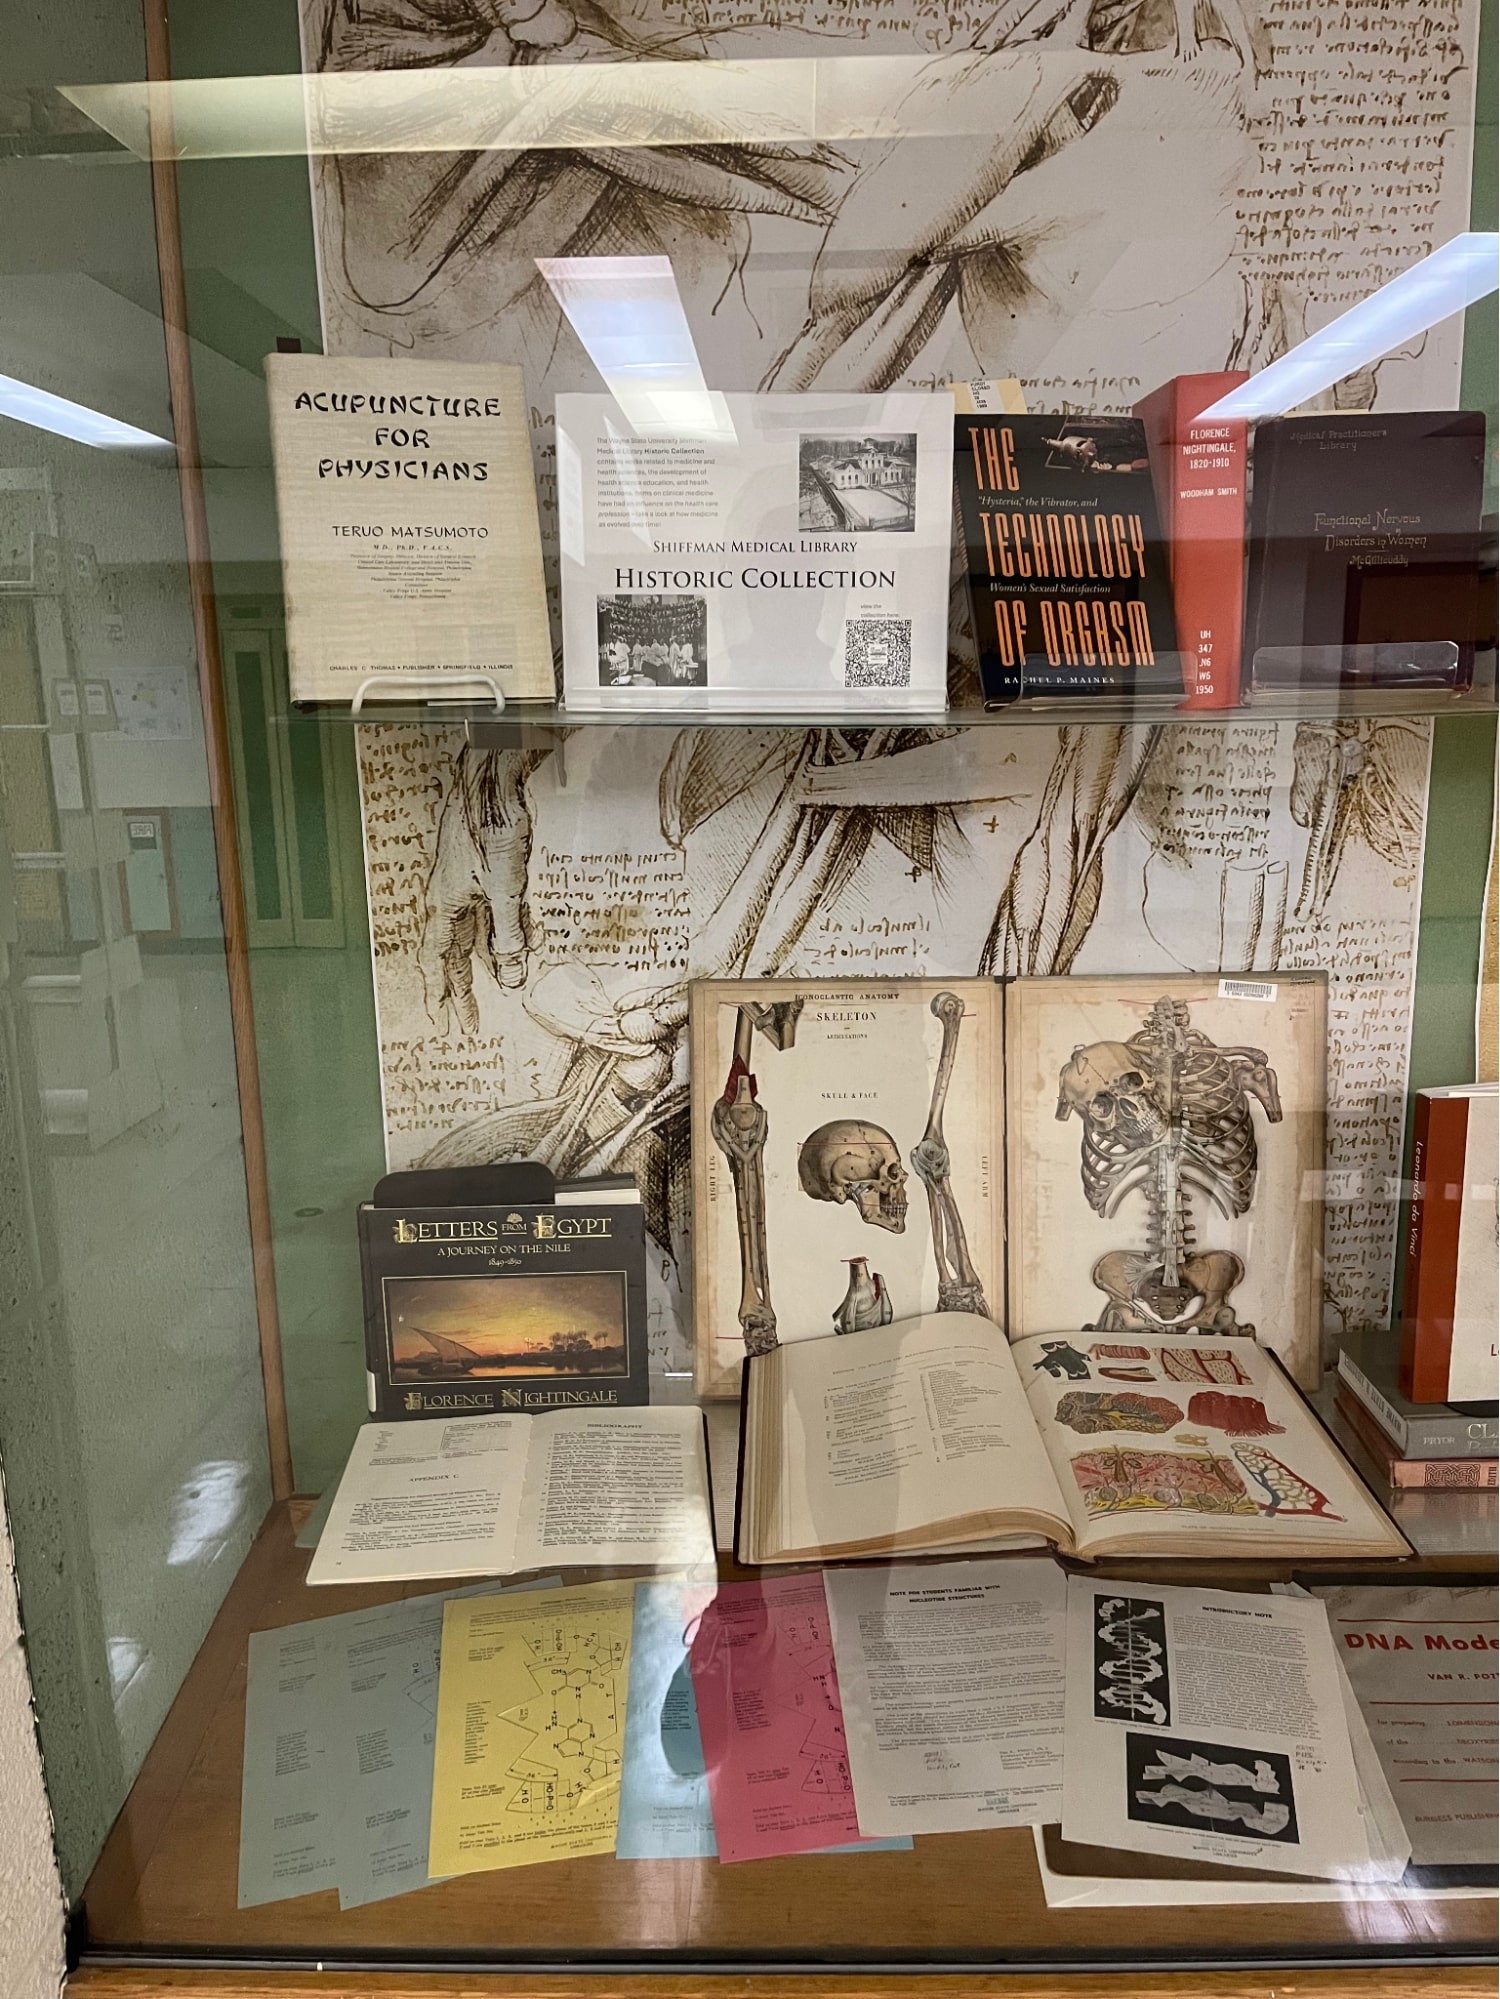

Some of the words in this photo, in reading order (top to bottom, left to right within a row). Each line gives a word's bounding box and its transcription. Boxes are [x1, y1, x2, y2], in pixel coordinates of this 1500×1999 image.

[294, 392, 501, 417] ACUPUNCTURE
[375, 427, 430, 448] FOR
[1190, 427, 1230, 439] FLORENCE
[1182, 442, 1237, 456] NIGHTINGALE,
[1319, 441, 1357, 451] Library
[968, 426, 1020, 492] THE
[1189, 457, 1230, 470] 1820-1910
[318, 458, 489, 481] PHYSICIANS
[659, 468, 700, 476] development
[1180, 489, 1214, 499] WOODHAM
[1217, 487, 1238, 498] SMITH
[1025, 496, 1040, 507] the
[1040, 496, 1079, 508] Vibrator,
[1080, 497, 1098, 508] and
[1314, 512, 1371, 531] Functional
[1372, 508, 1421, 530] Nervous
[332, 525, 384, 538] TERUO
[391, 526, 489, 539] MATSUMOTO
[653, 540, 726, 553] SHIFFMAN
[731, 540, 796, 553] MEDICAL
[800, 540, 858, 553] LIBRARY
[979, 511, 1147, 579] TECHNOLOGY
[1325, 534, 1375, 551] Disorders
[1378, 537, 1386, 548] in
[1386, 531, 1427, 550] Women
[615, 567, 734, 589] HISTORIC
[741, 567, 897, 589] COLLECTION
[1029, 582, 1058, 593] Sexual
[1060, 582, 1111, 595] Satisfaction
[994, 600, 1028, 667] OF
[1039, 600, 1155, 667] ORGASM
[1200, 630, 1211, 639] UH
[1198, 643, 1213, 653] 347
[1004, 675, 1052, 684] RACHEL
[1070, 676, 1116, 684] MAINES
[1195, 684, 1214, 694] 1950
[816, 1012, 877, 1021] SKELETON
[1412, 1141, 1423, 1200] Leonardo
[1411, 1204, 1420, 1222] da
[393, 1218, 498, 1243] LETTERS
[502, 1223, 527, 1231] FROM
[533, 1214, 612, 1240] EGYPT
[1409, 1227, 1418, 1257] Vinci
[447, 1245, 496, 1256] JOURNEY
[500, 1245, 516, 1254] ON
[520, 1244, 542, 1253] THE
[546, 1243, 571, 1253] NILE
[488, 1258, 522, 1267] 1849-1850
[1490, 1344, 1499, 1356] L
[404, 1392, 494, 1411] FLORENCE
[501, 1388, 617, 1408] NIGHTINGALE
[1423, 1436, 1455, 1445] PRYOR
[1467, 1423, 1499, 1439] CL
[408, 1474, 450, 1483] APPENDIX
[1202, 1606, 1252, 1616] INTRODUCTORY
[1344, 1633, 1414, 1651] DNA
